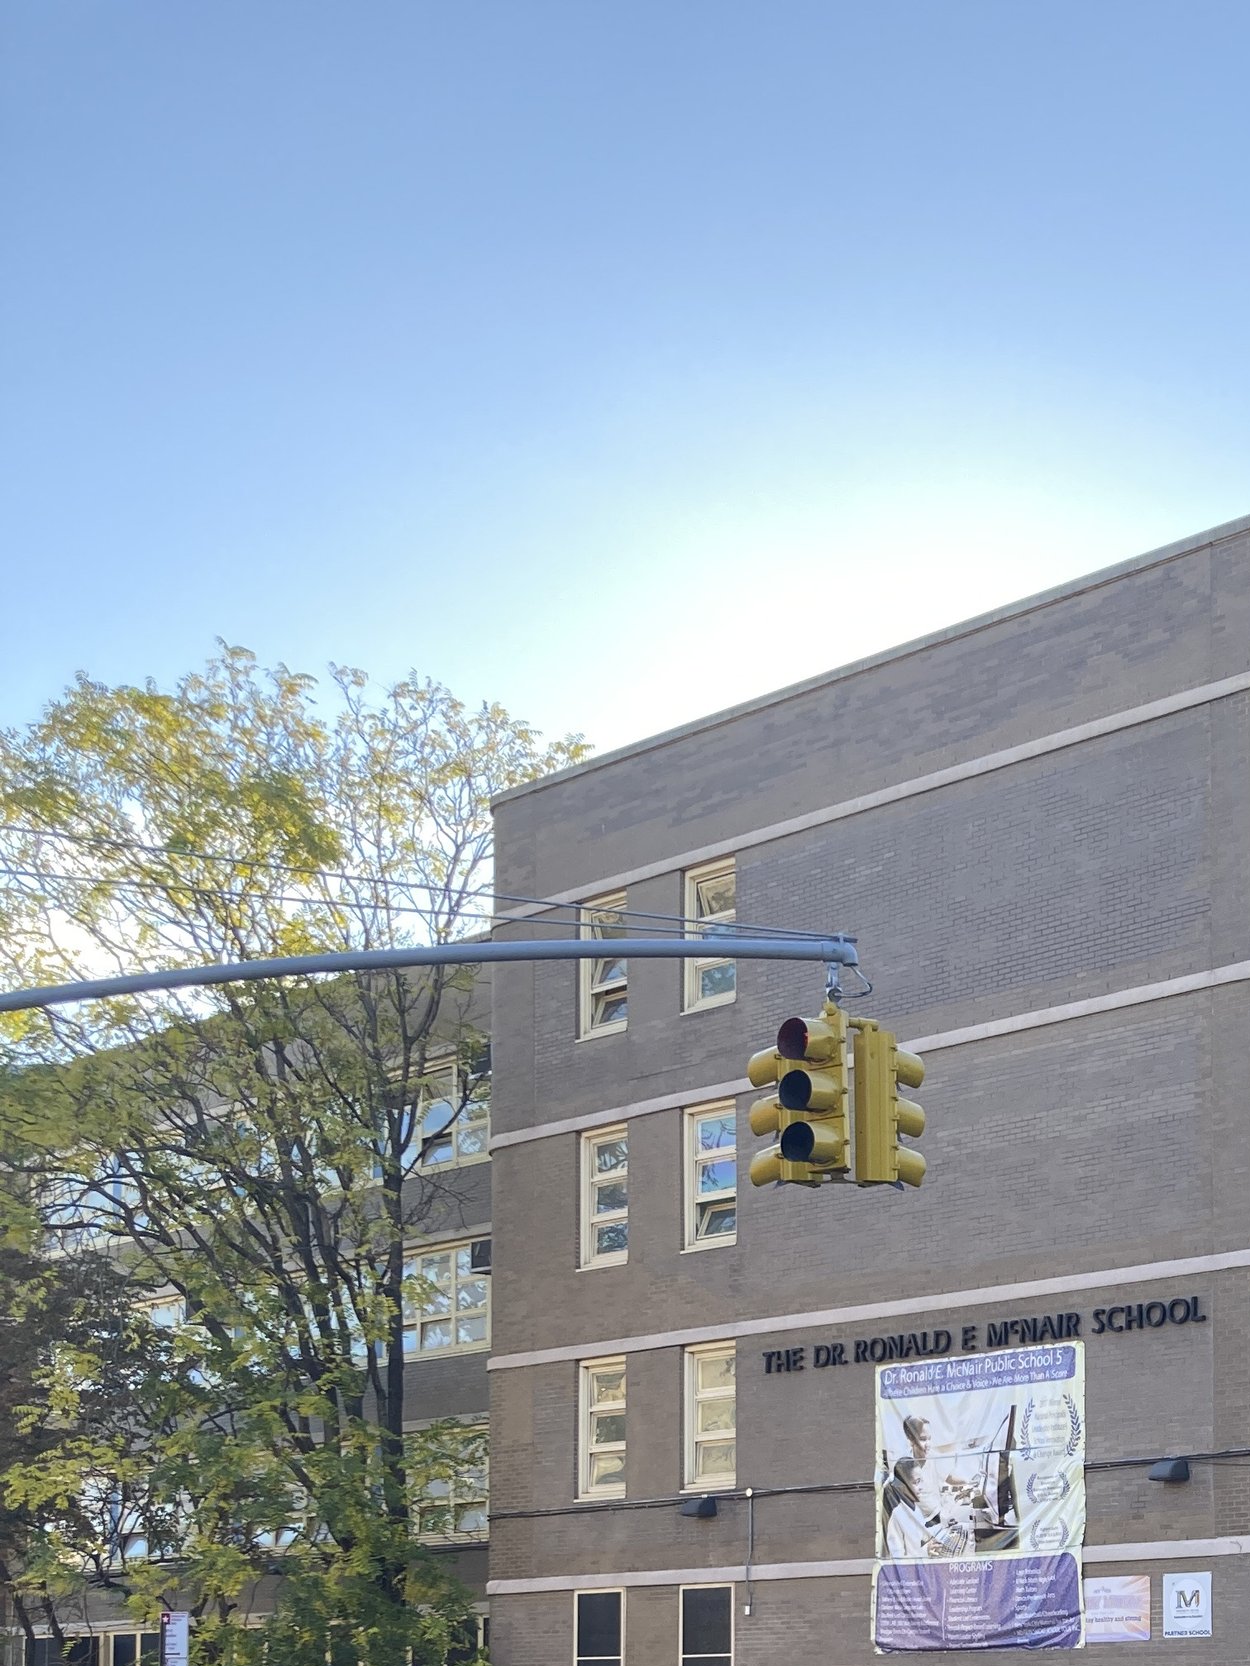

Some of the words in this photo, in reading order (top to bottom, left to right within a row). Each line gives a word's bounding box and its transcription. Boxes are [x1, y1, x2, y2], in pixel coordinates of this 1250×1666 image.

[762, 1347, 804, 1374] THE
[813, 1342, 848, 1369] DR.
[854, 1329, 952, 1363] RONALD
[961, 1325, 976, 1351] E
[1091, 1296, 1207, 1334] SCHOOL
[884, 1371, 898, 1385] Dr.
[900, 1365, 934, 1384] Ronald
[947, 1362, 983, 1378] McNair
[985, 1356, 1016, 1373] Public
[1018, 1350, 1054, 1369] School
[1056, 1349, 1063, 1364] 5
[949, 1561, 993, 1573] PROGRAMS
